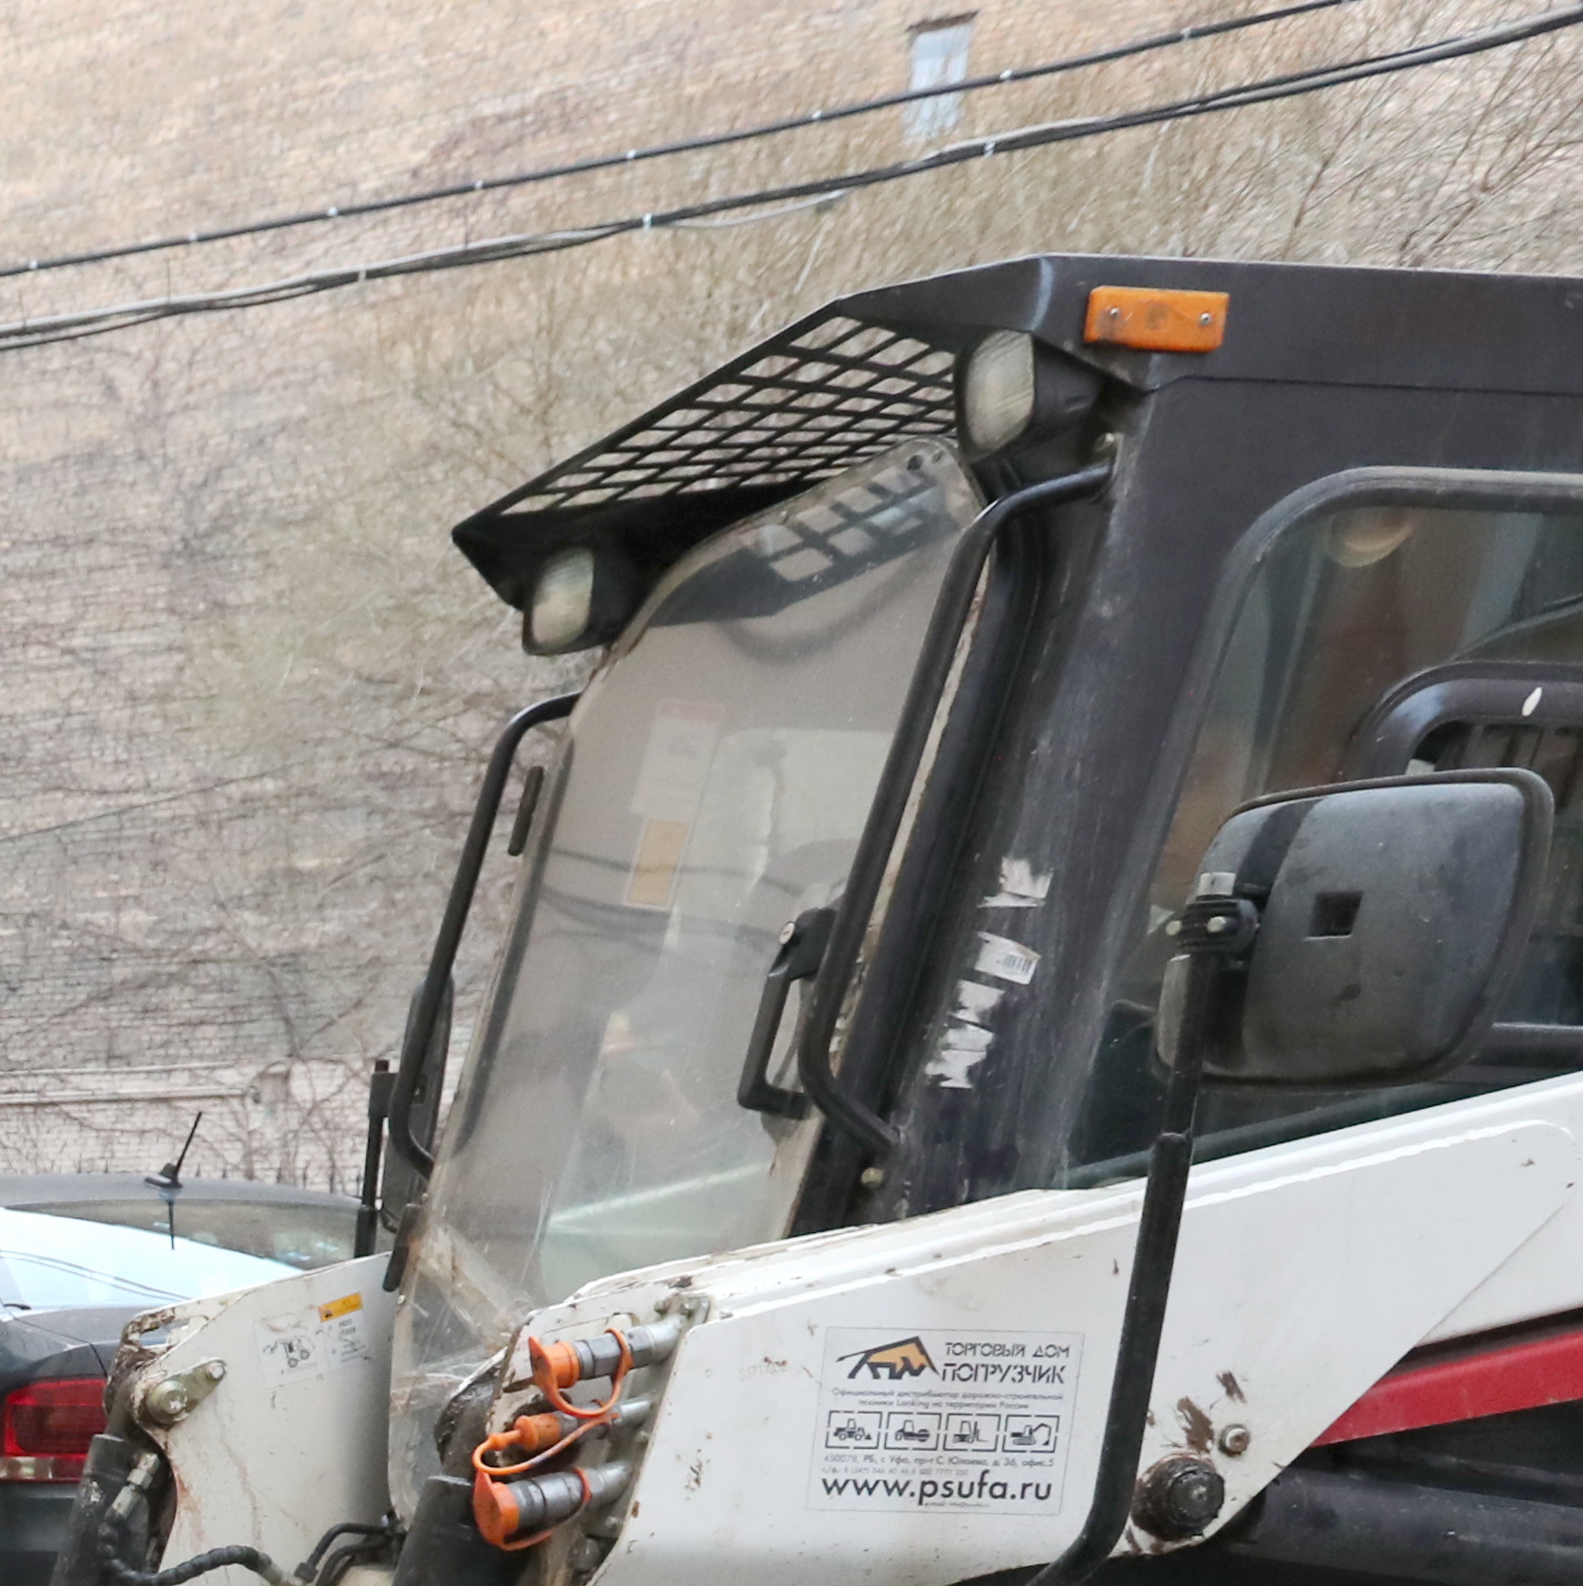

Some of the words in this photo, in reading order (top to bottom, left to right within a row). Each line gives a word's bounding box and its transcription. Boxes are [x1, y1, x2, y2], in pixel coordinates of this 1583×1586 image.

[945, 1342, 1026, 1357] ТОРГОВЫЙ
[1032, 1344, 1070, 1358] ДОМ
[941, 1362, 1066, 1383] ПОГРУЗЧИК
[821, 1469, 1052, 1506] www.psufa.ru
